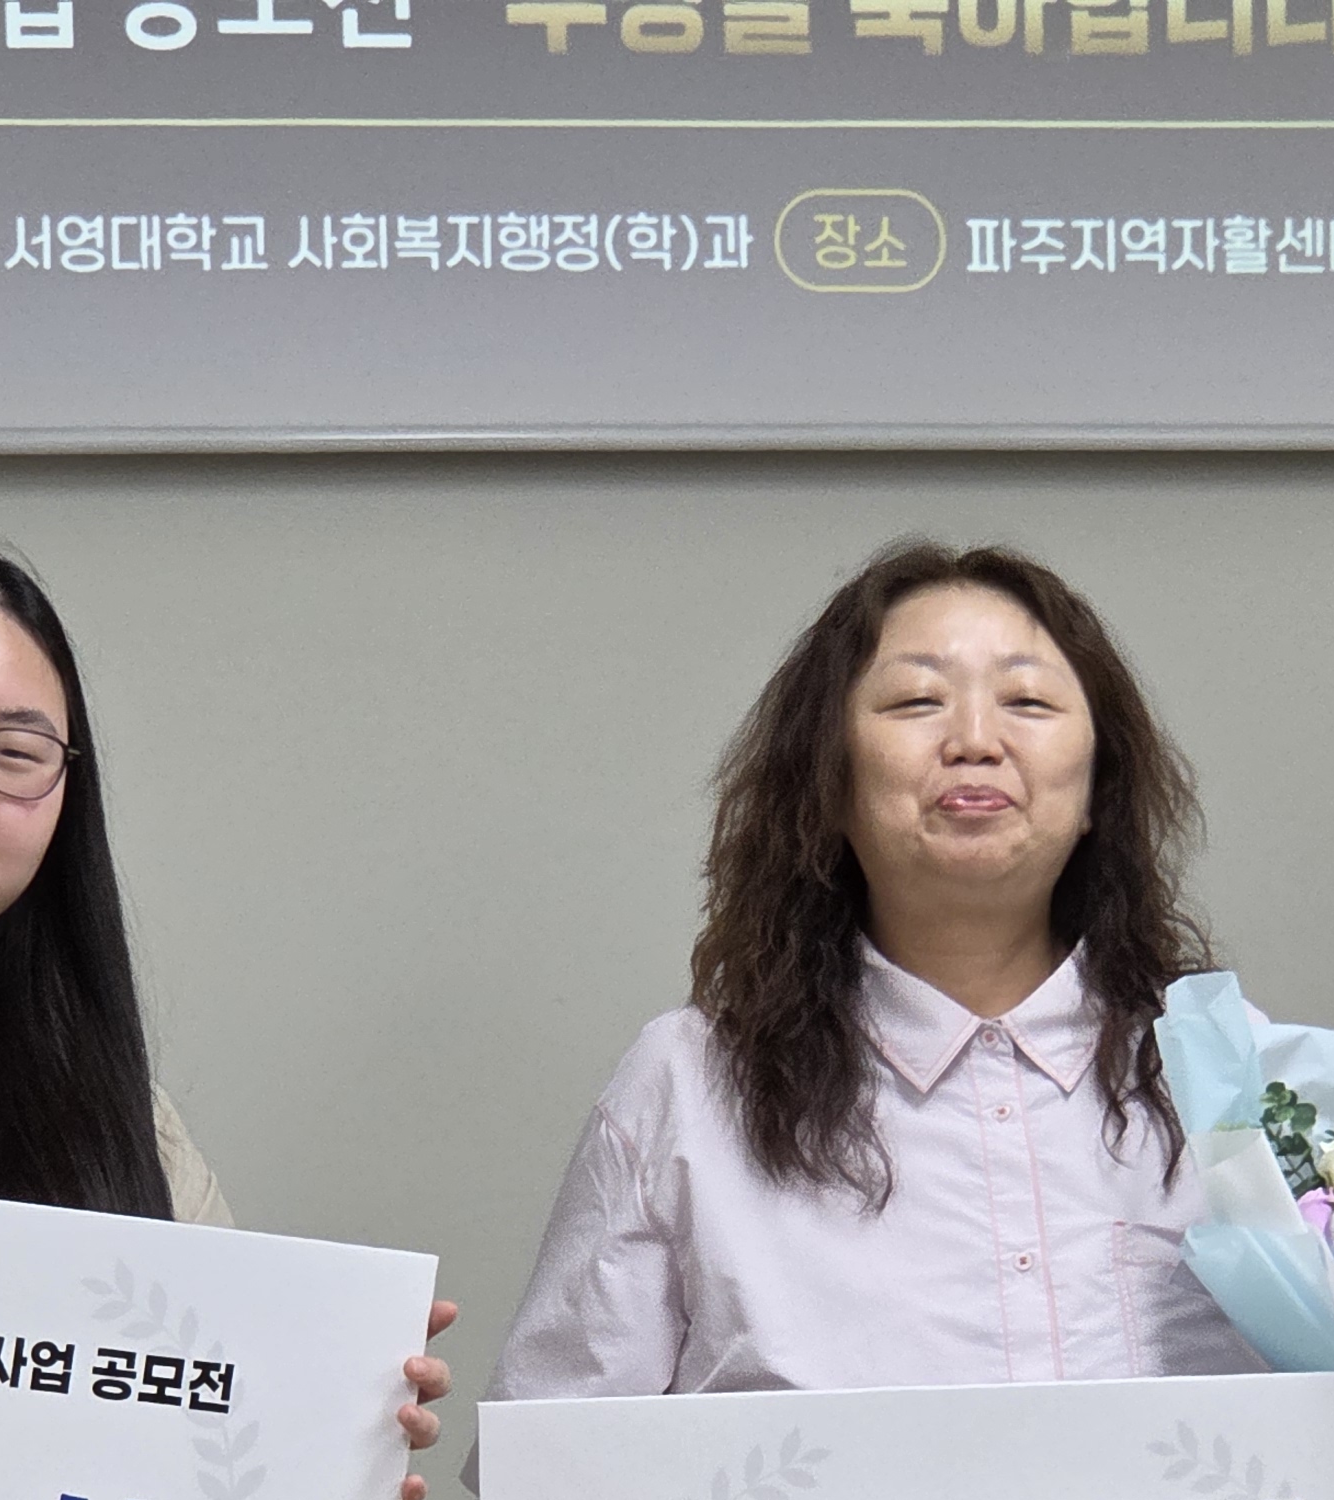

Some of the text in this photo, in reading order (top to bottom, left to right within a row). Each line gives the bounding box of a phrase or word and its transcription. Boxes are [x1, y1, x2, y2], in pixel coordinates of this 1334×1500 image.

[4, 212, 269, 273] 서영대학교
[287, 211, 754, 273] 사회복지행정(학)과
[814, 214, 908, 269] 장소
[91, 1348, 235, 1414] 공모전
